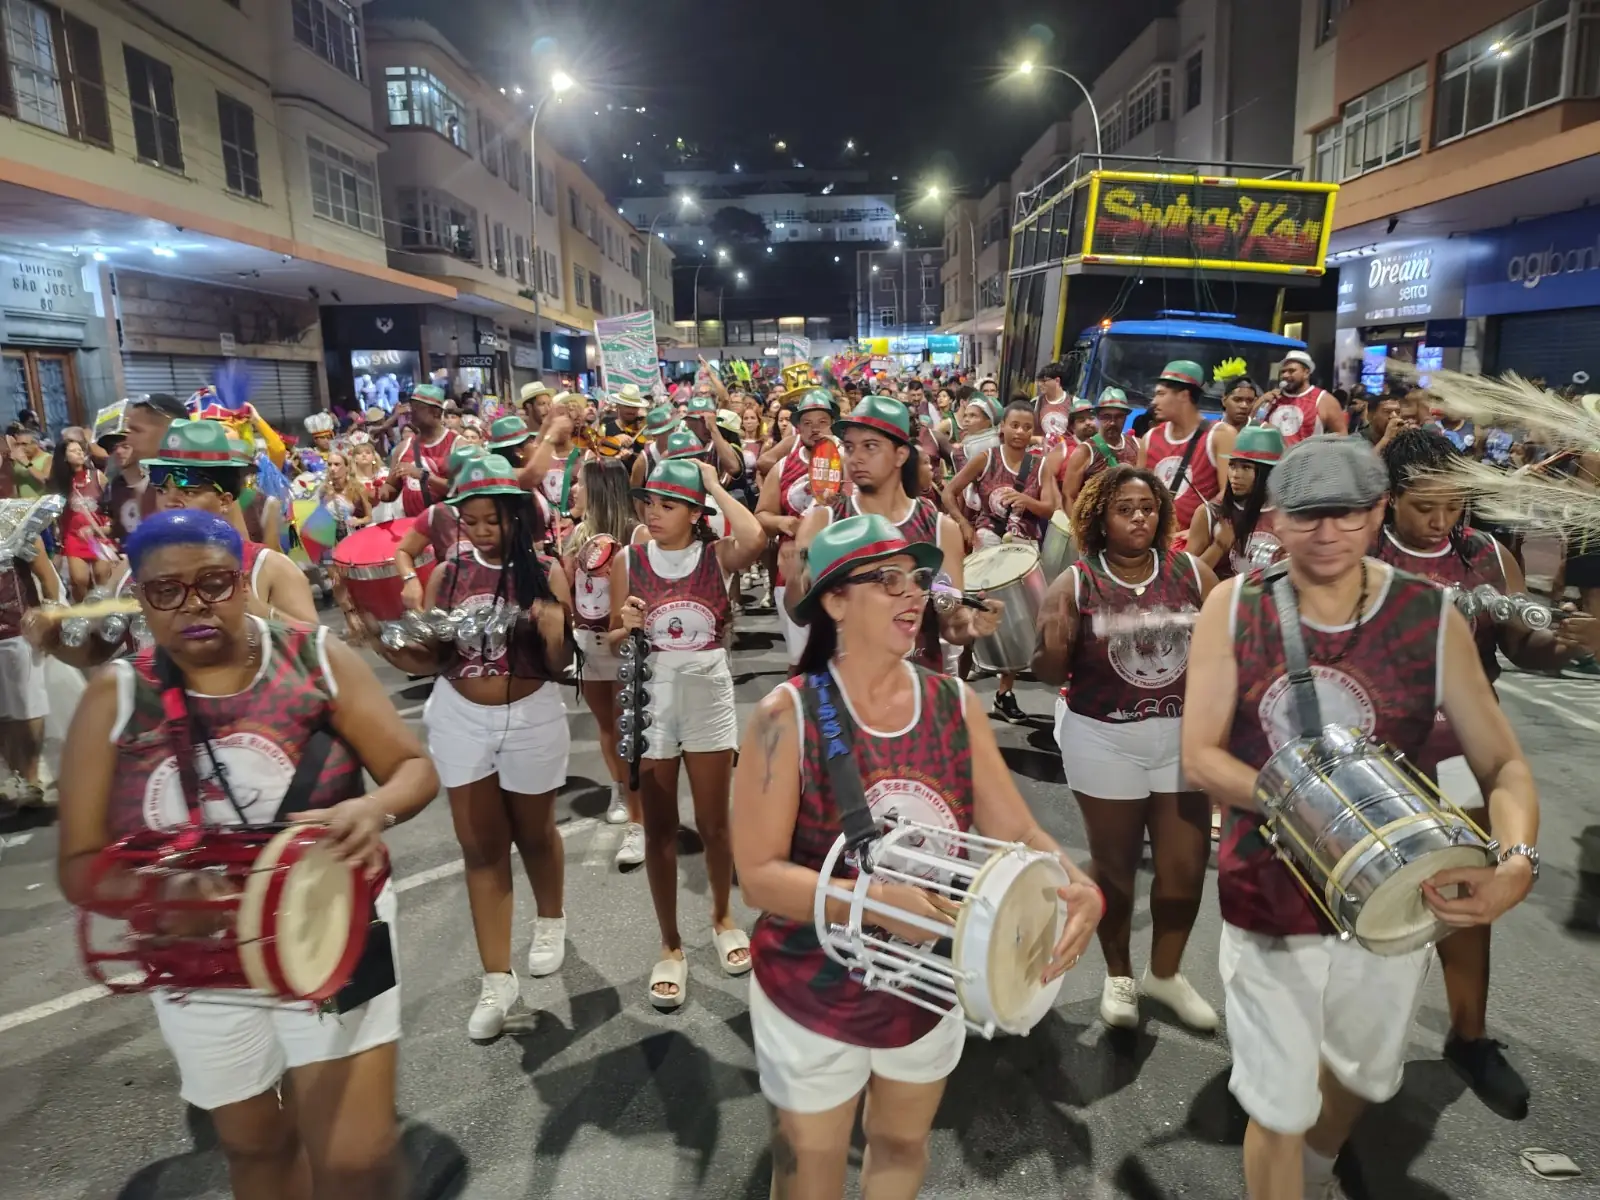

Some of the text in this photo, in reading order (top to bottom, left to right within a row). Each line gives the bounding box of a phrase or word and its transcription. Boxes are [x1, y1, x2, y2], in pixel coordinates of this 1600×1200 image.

[1369, 258, 1430, 289] Dream
[1399, 284, 1428, 301] serra
[459, 356, 493, 367] DREZO
[647, 606, 668, 626] BLOCO
